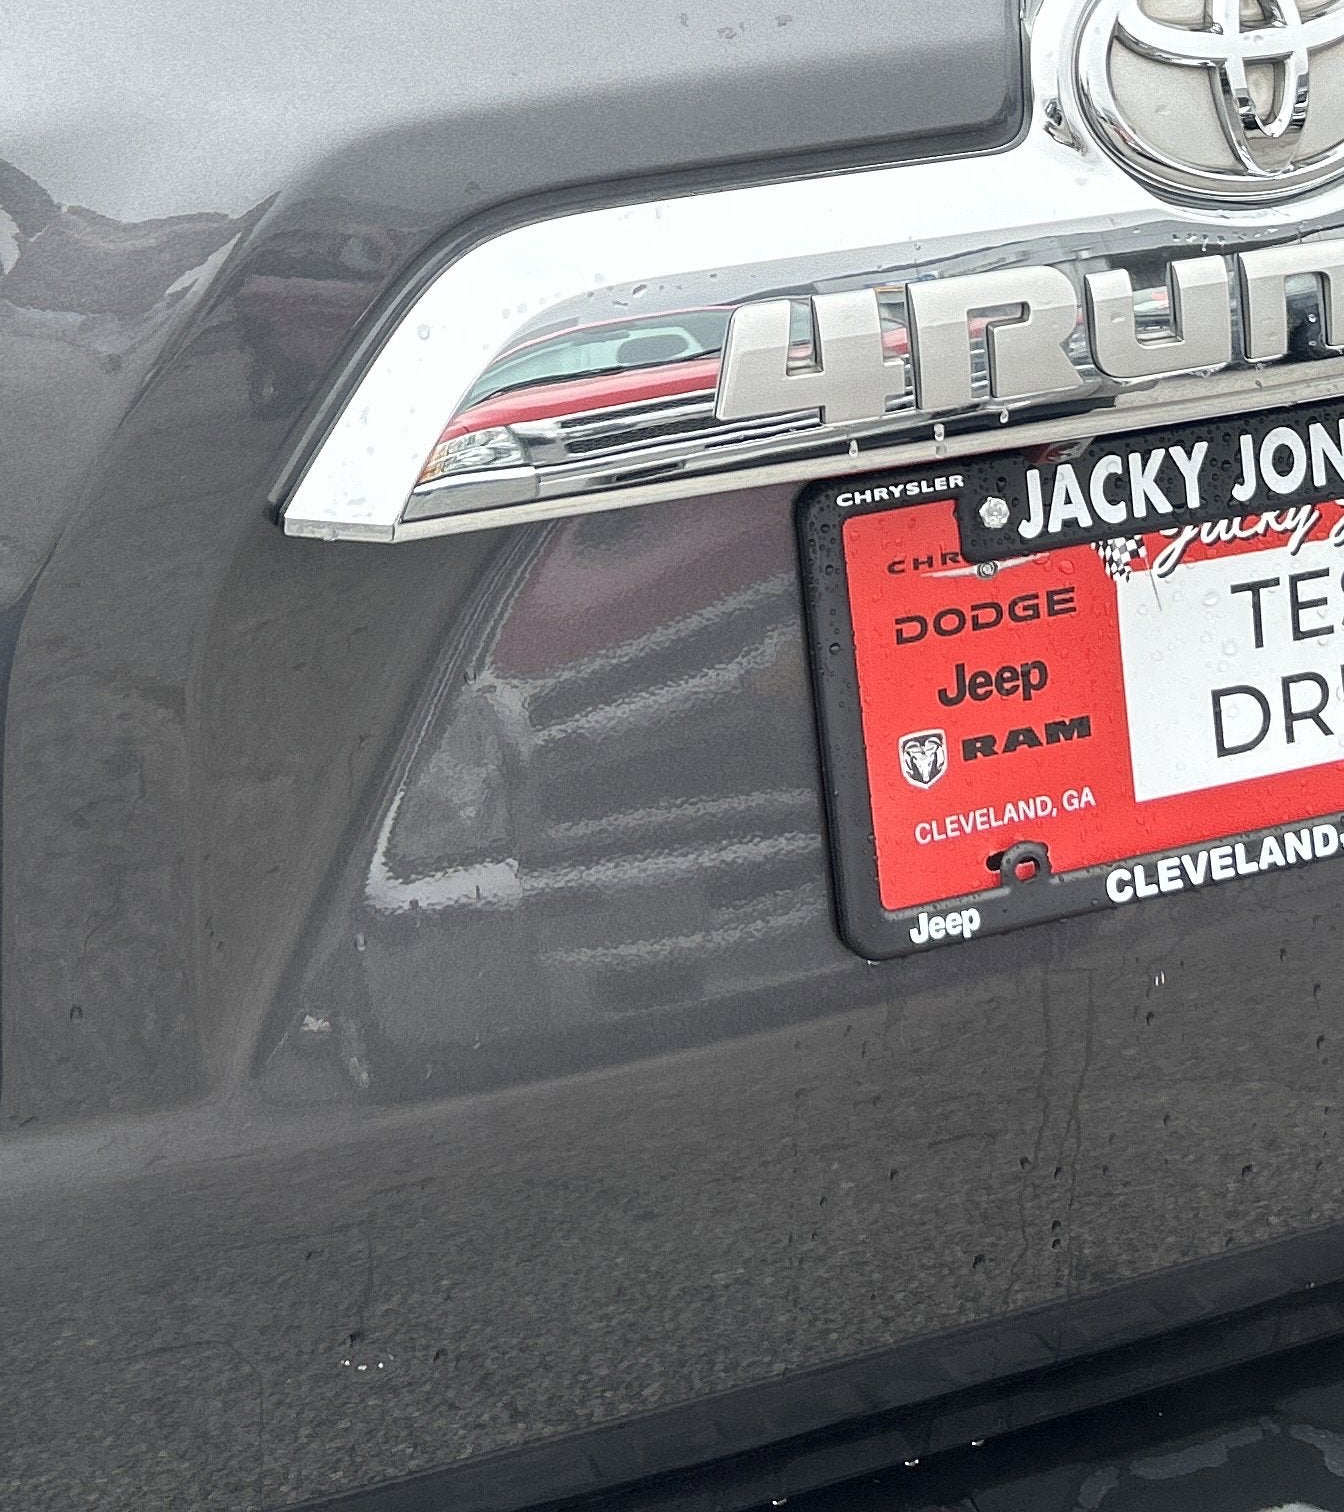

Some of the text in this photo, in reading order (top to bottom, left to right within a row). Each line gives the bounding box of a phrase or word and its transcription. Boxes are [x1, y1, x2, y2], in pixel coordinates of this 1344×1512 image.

[836, 474, 965, 507] CHRYSLER
[1018, 441, 1208, 539] JACKY
[894, 585, 1077, 646] DODGE
[937, 659, 1049, 707] Jeep
[961, 715, 1092, 762] RAM
[914, 786, 1096, 845] CLEVELAND, GA
[909, 908, 981, 944] Jeep
